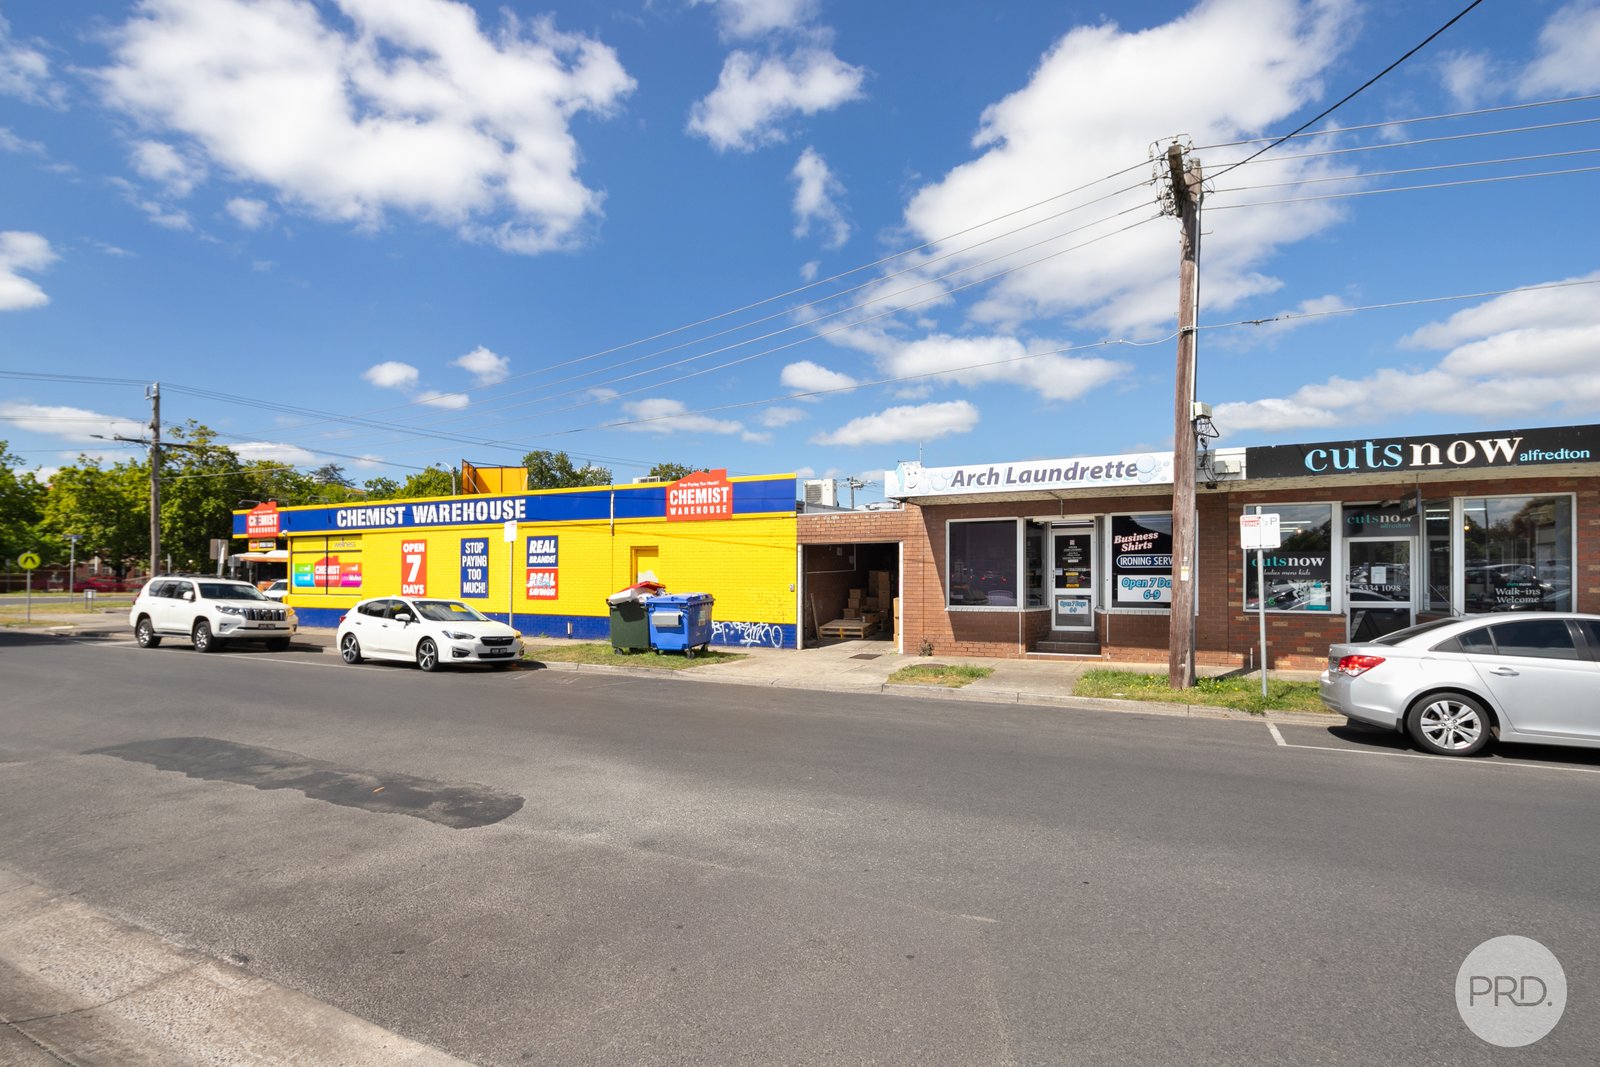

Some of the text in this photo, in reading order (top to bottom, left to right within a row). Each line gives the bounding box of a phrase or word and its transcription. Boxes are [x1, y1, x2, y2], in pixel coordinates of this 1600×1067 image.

[1519, 448, 1590, 463] alfredton
[951, 460, 1138, 487] Arch Laundrette
[669, 487, 730, 506] CHEMIST
[336, 499, 526, 527] CHEMIST WAREHOUSE
[670, 505, 728, 516] WAREHOUSE
[1113, 532, 1159, 544] Business
[402, 543, 425, 553] OPEN
[465, 542, 484, 554] STOP
[529, 539, 556, 554] REAL
[1121, 541, 1153, 552] Shirts
[462, 555, 487, 567] PAYING
[528, 555, 556, 564] BRANDS!
[1120, 556, 1152, 566] IRONING
[406, 554, 422, 583] 7
[467, 568, 482, 580] TOO
[402, 584, 425, 595] DAYS
[463, 582, 486, 594] MUCH!
[1121, 577, 1148, 590] Open
[1149, 577, 1157, 588] 7
[1359, 584, 1401, 592] 5334 1098
[1143, 589, 1161, 600] 6-9
[1495, 587, 1541, 596] Walk-ins
[1496, 596, 1540, 604] Welcome
